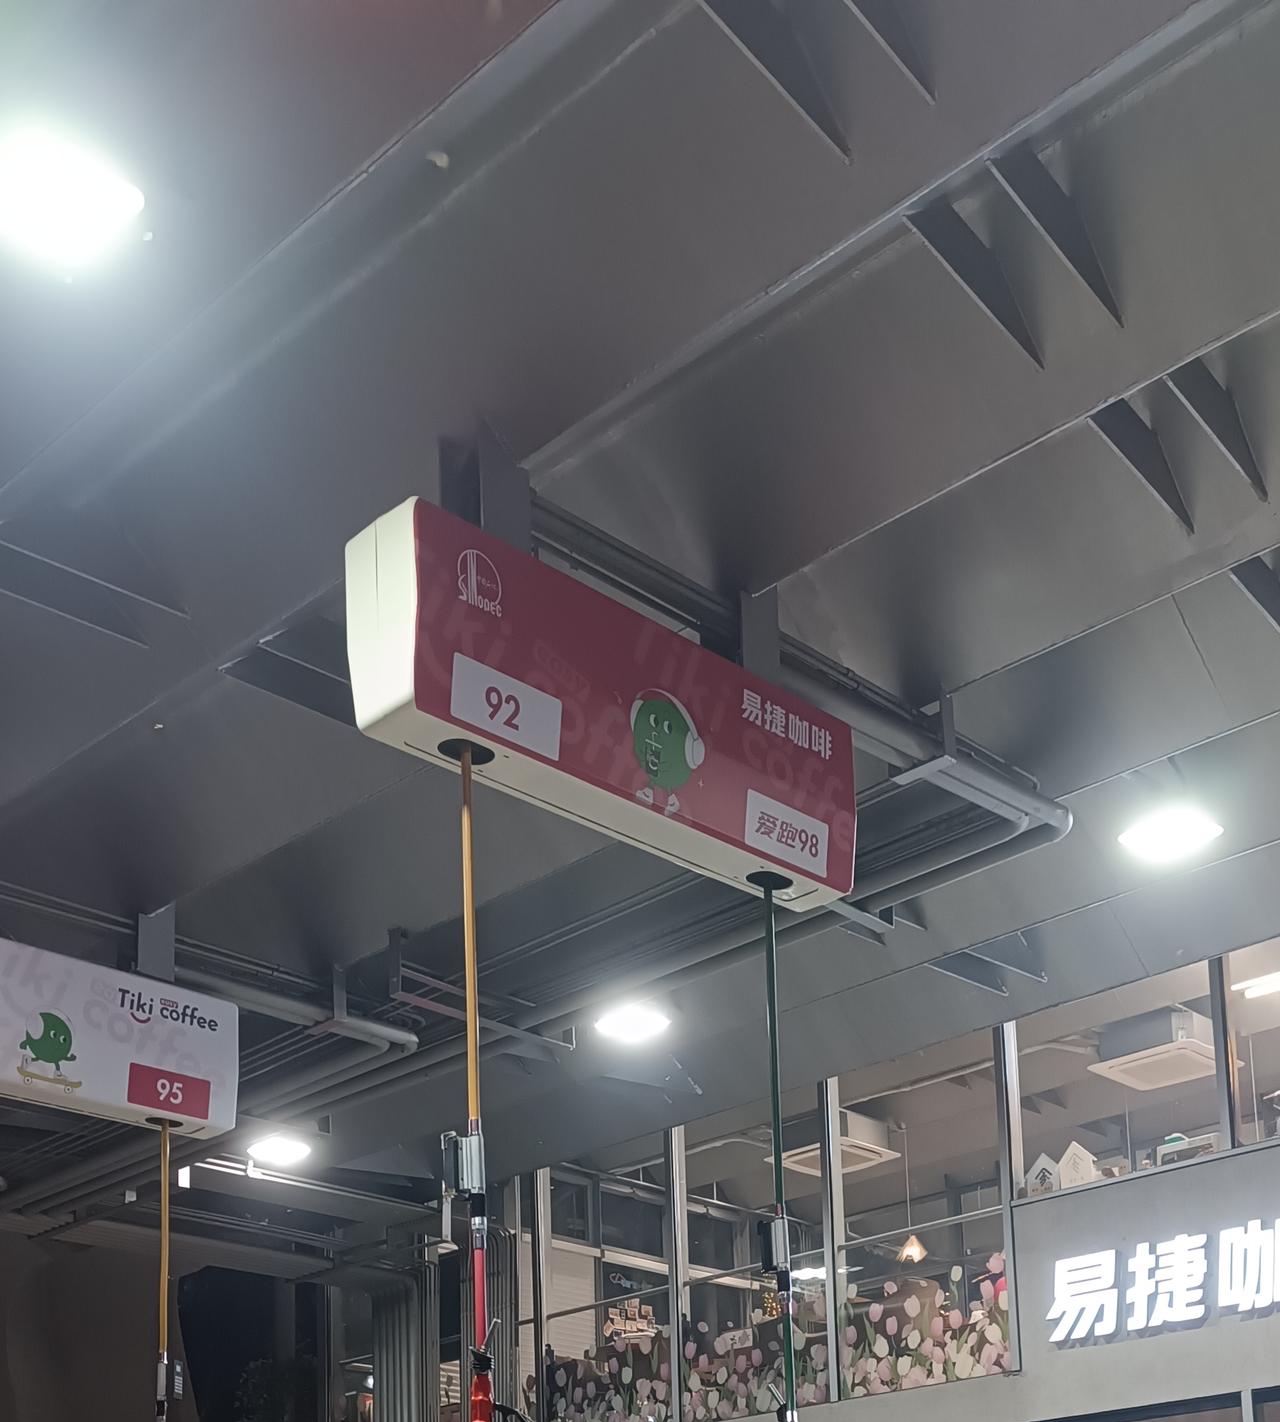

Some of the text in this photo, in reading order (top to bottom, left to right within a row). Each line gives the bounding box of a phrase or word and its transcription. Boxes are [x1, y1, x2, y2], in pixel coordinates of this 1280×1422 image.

[485, 686, 521, 731] 92
[740, 688, 833, 761] 易捷咖啡
[755, 811, 820, 859] 爱跑98
[118, 988, 219, 1032] Tiki coffee
[156, 1078, 183, 1104] 95
[1045, 1218, 1280, 1343] 易捷咖
